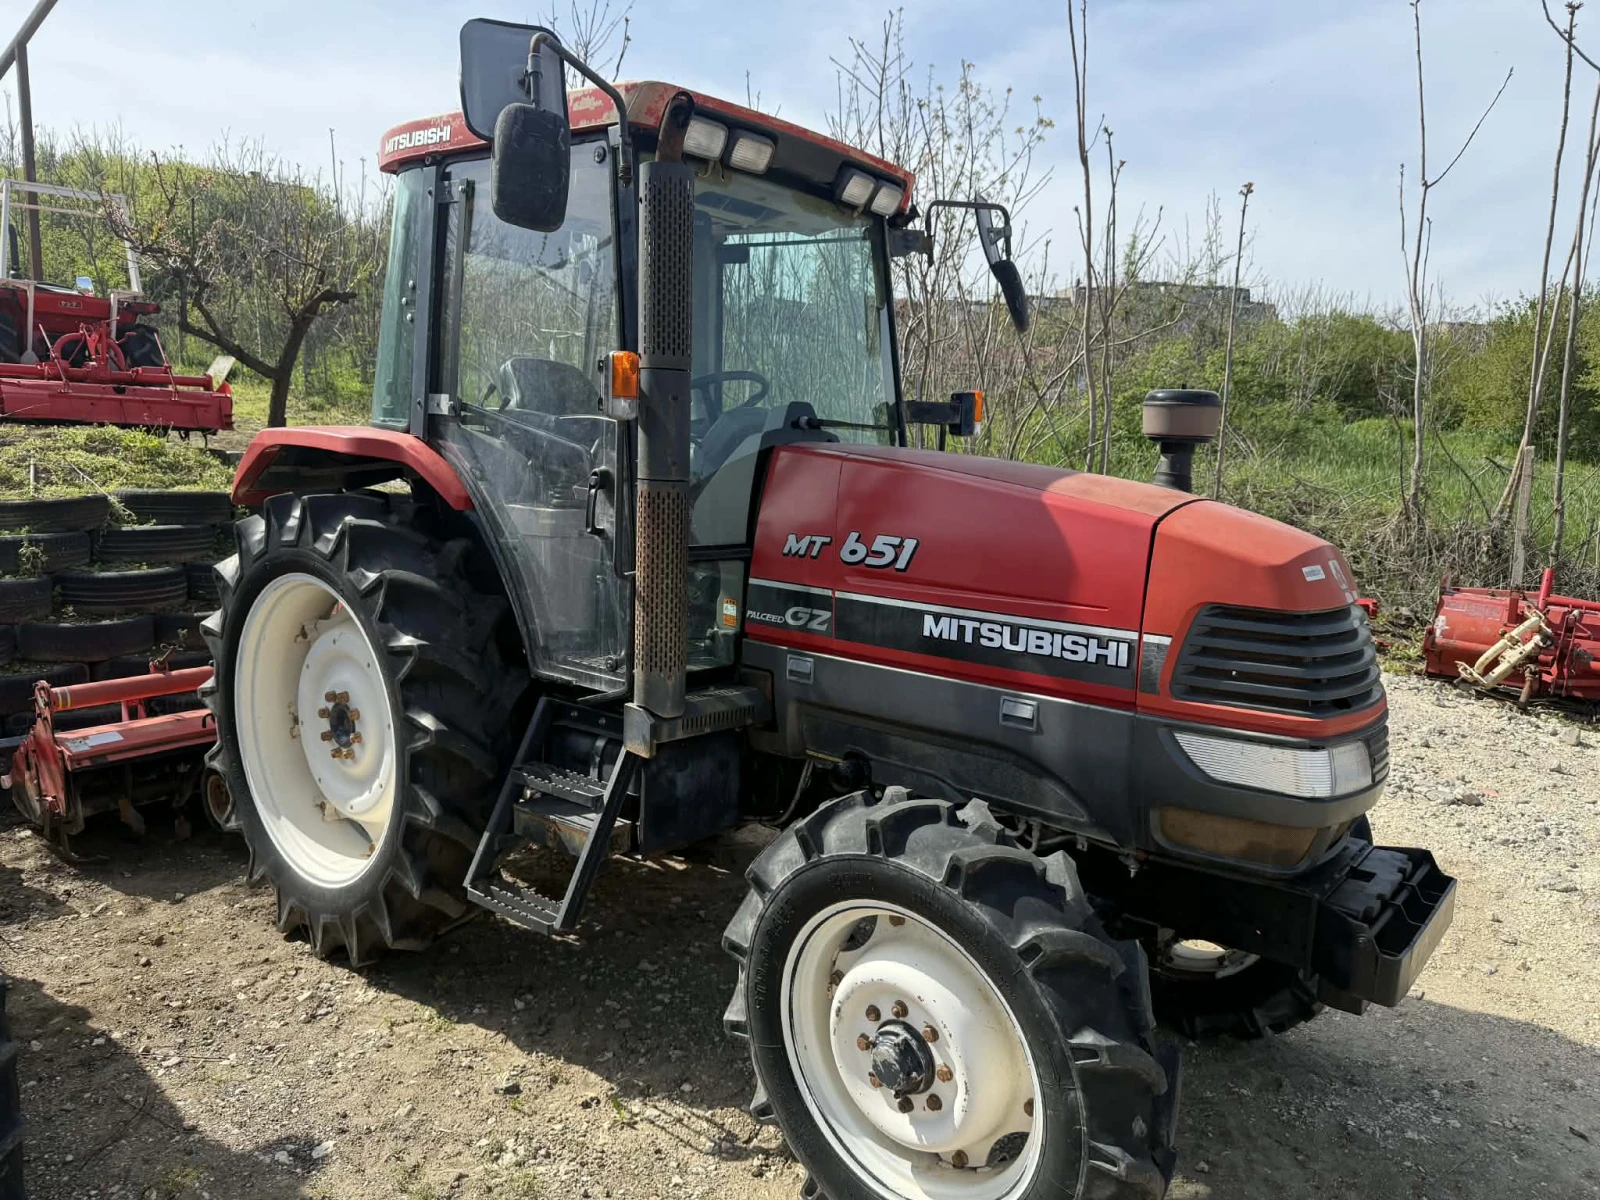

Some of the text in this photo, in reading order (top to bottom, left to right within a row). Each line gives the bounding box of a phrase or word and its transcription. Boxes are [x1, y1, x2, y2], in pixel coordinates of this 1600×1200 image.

[385, 125, 451, 155] MITSUBISHI
[782, 531, 919, 572] MT 651
[747, 609, 785, 624] PALCEED
[785, 606, 832, 631] GZ
[922, 613, 1130, 668] MITSUBISHI
